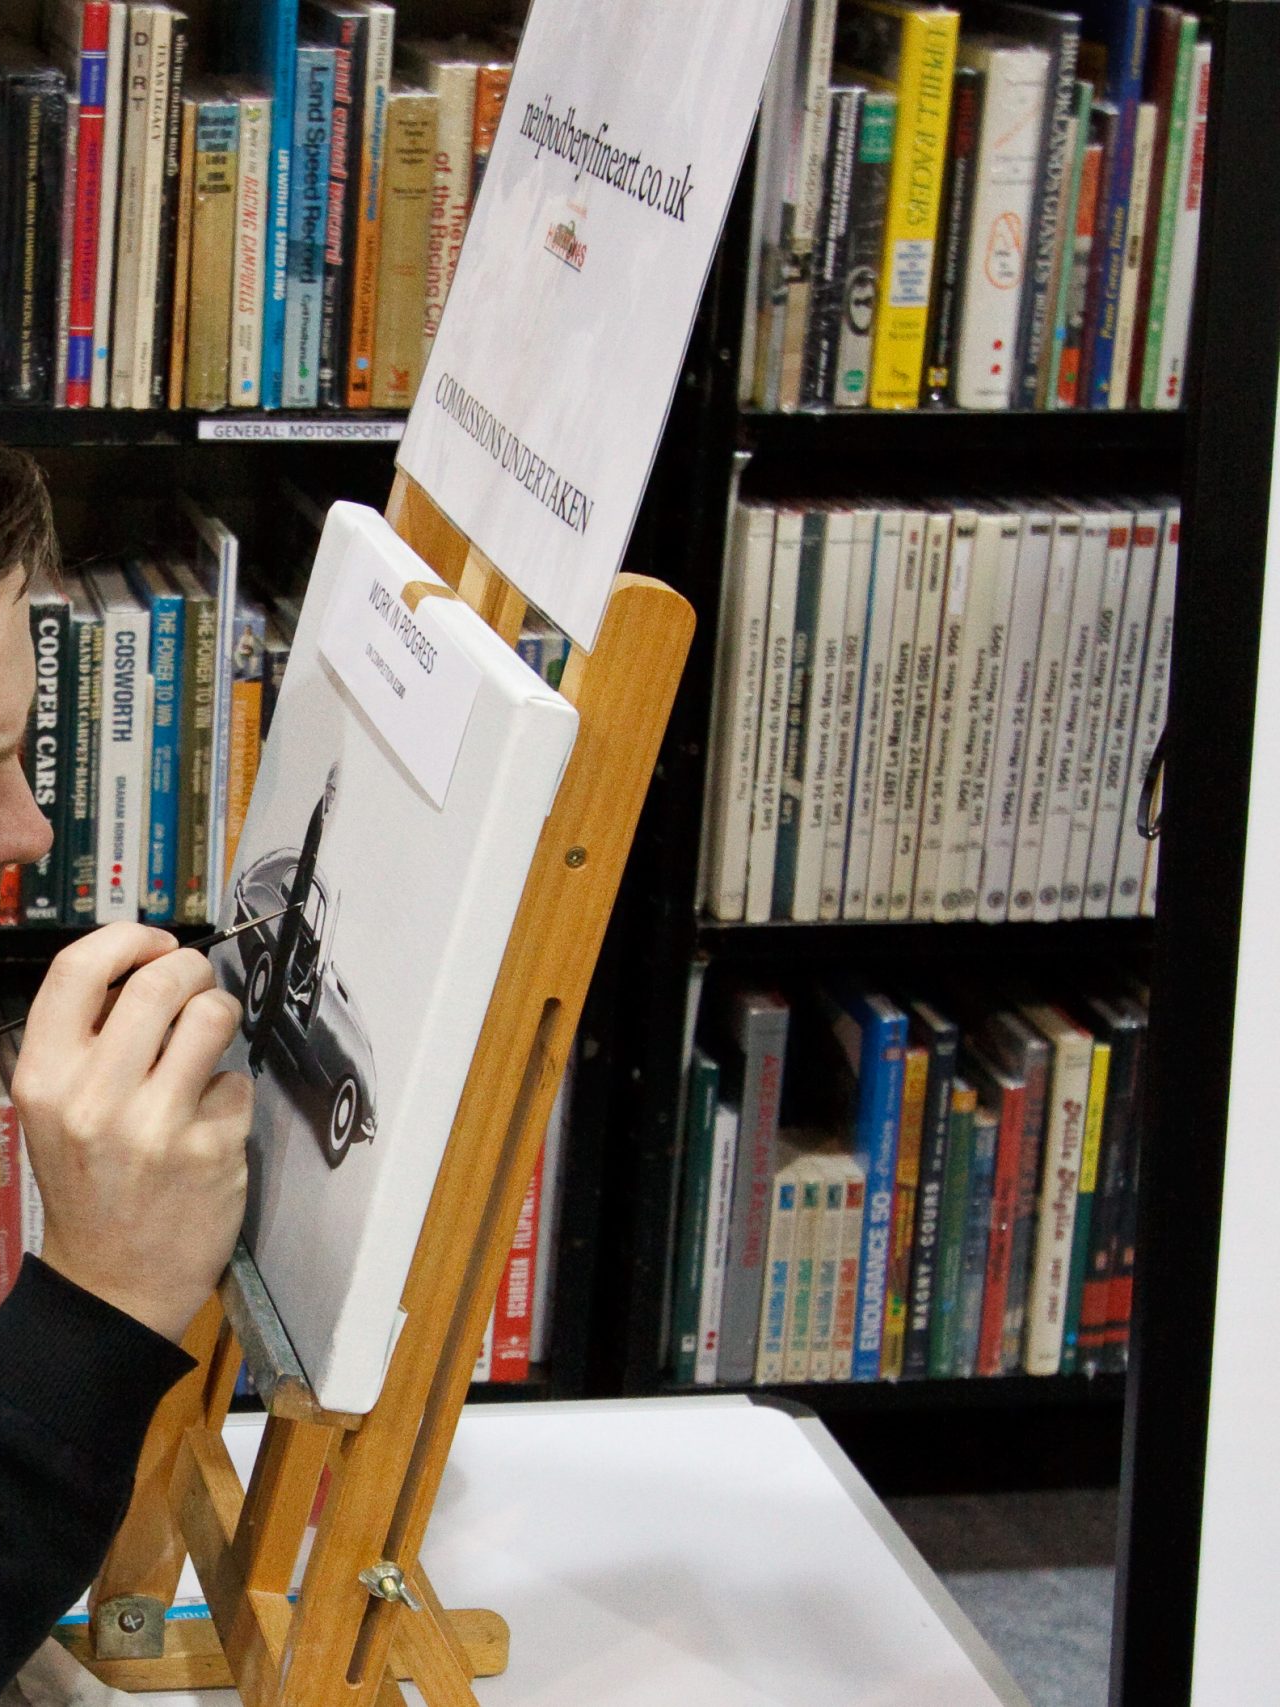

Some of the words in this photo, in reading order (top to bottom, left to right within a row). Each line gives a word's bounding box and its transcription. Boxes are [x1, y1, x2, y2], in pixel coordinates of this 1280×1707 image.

[305, 66, 327, 121] Land
[151, 88, 163, 142] LEGACY
[278, 149, 292, 170] LIFE
[299, 127, 324, 200] Speed
[432, 151, 453, 173] of
[520, 95, 694, 222] neilpodberyfineart.co.uk
[240, 175, 259, 230] RACING
[277, 170, 291, 204] WITH
[431, 184, 450, 220] the
[276, 204, 290, 226] THE
[274, 229, 288, 266] SPEED
[298, 205, 320, 283] Record
[421, 224, 447, 298] Racing
[237, 233, 258, 314] CAMPBELLS
[272, 268, 287, 300] KING
[213, 424, 285, 438] GENERAL:
[291, 424, 391, 438] MOTORSPORT
[436, 372, 507, 461] COMMISSIONS
[502, 430, 595, 538] UNDERTAKEN
[158, 610, 176, 632] THE
[197, 612, 215, 636] THE
[369, 578, 394, 622] WORK
[390, 603, 402, 632] IN
[396, 611, 438, 674] PROGRESS
[36, 618, 58, 731] COOPER
[157, 637, 175, 680] POWER
[195, 642, 213, 683] POWER
[112, 631, 134, 741] COSWORTH
[156, 685, 173, 700] TO
[195, 686, 211, 702] TO
[155, 703, 173, 726] WIN
[193, 706, 210, 728] WIN
[34, 736, 55, 807] CARS
[114, 775, 125, 816] GRAHAM
[113, 821, 123, 859] ROBSON
[859, 1229, 888, 1351] ENDURANCE
